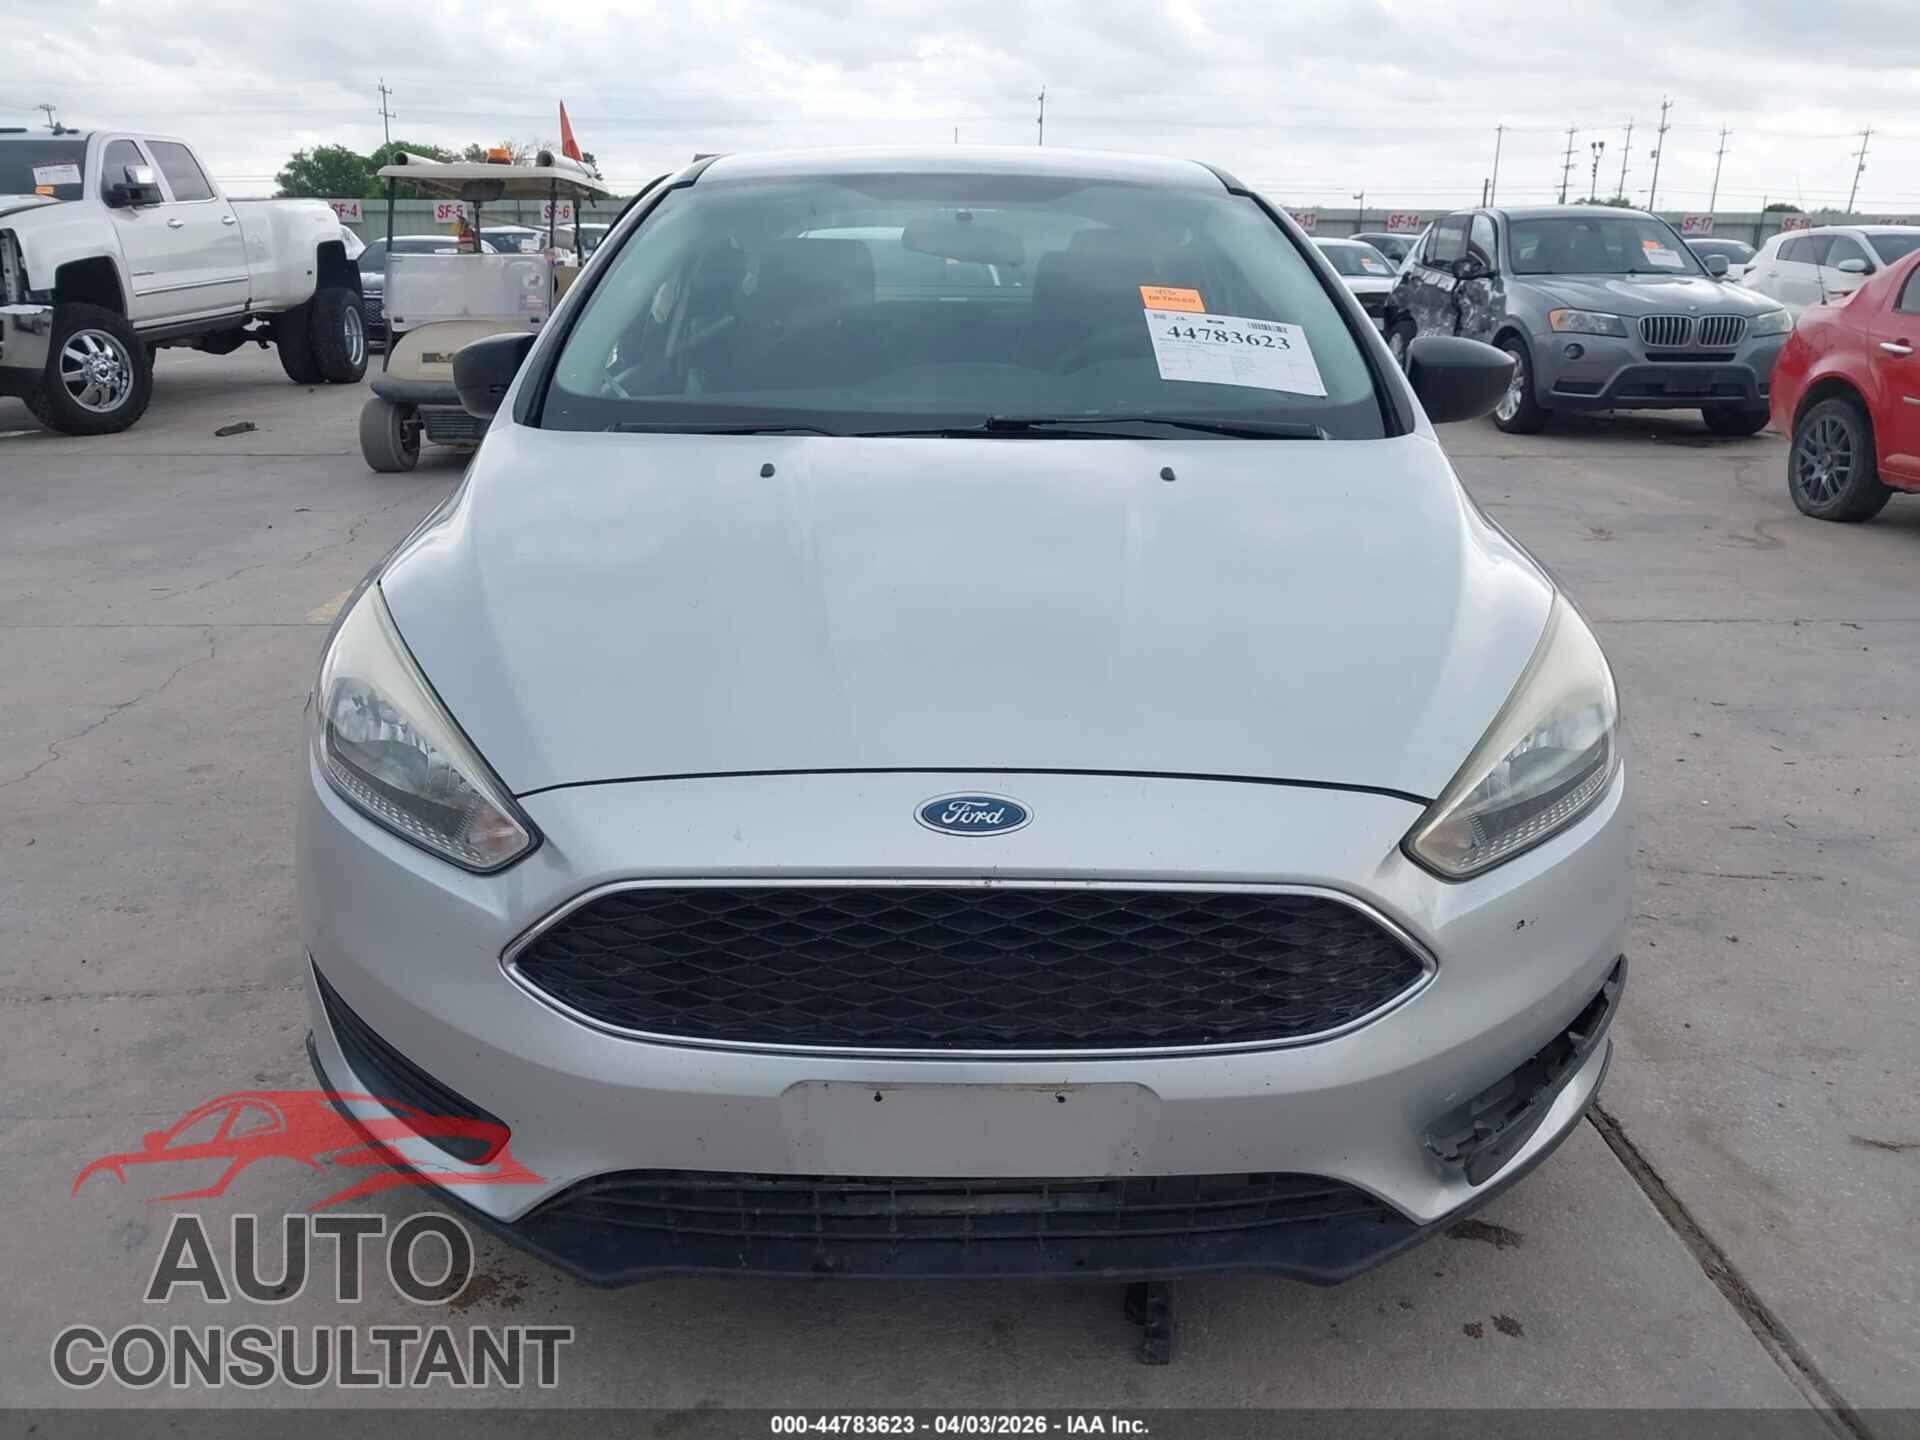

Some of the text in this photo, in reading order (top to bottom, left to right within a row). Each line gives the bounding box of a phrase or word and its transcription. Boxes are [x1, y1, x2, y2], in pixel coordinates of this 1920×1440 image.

[437, 204, 464, 219] SF-5
[1389, 213, 1419, 229] SF-14
[1682, 216, 1713, 231] SF-17
[1166, 325, 1291, 350] 44783623
[941, 800, 1005, 824] Ford
